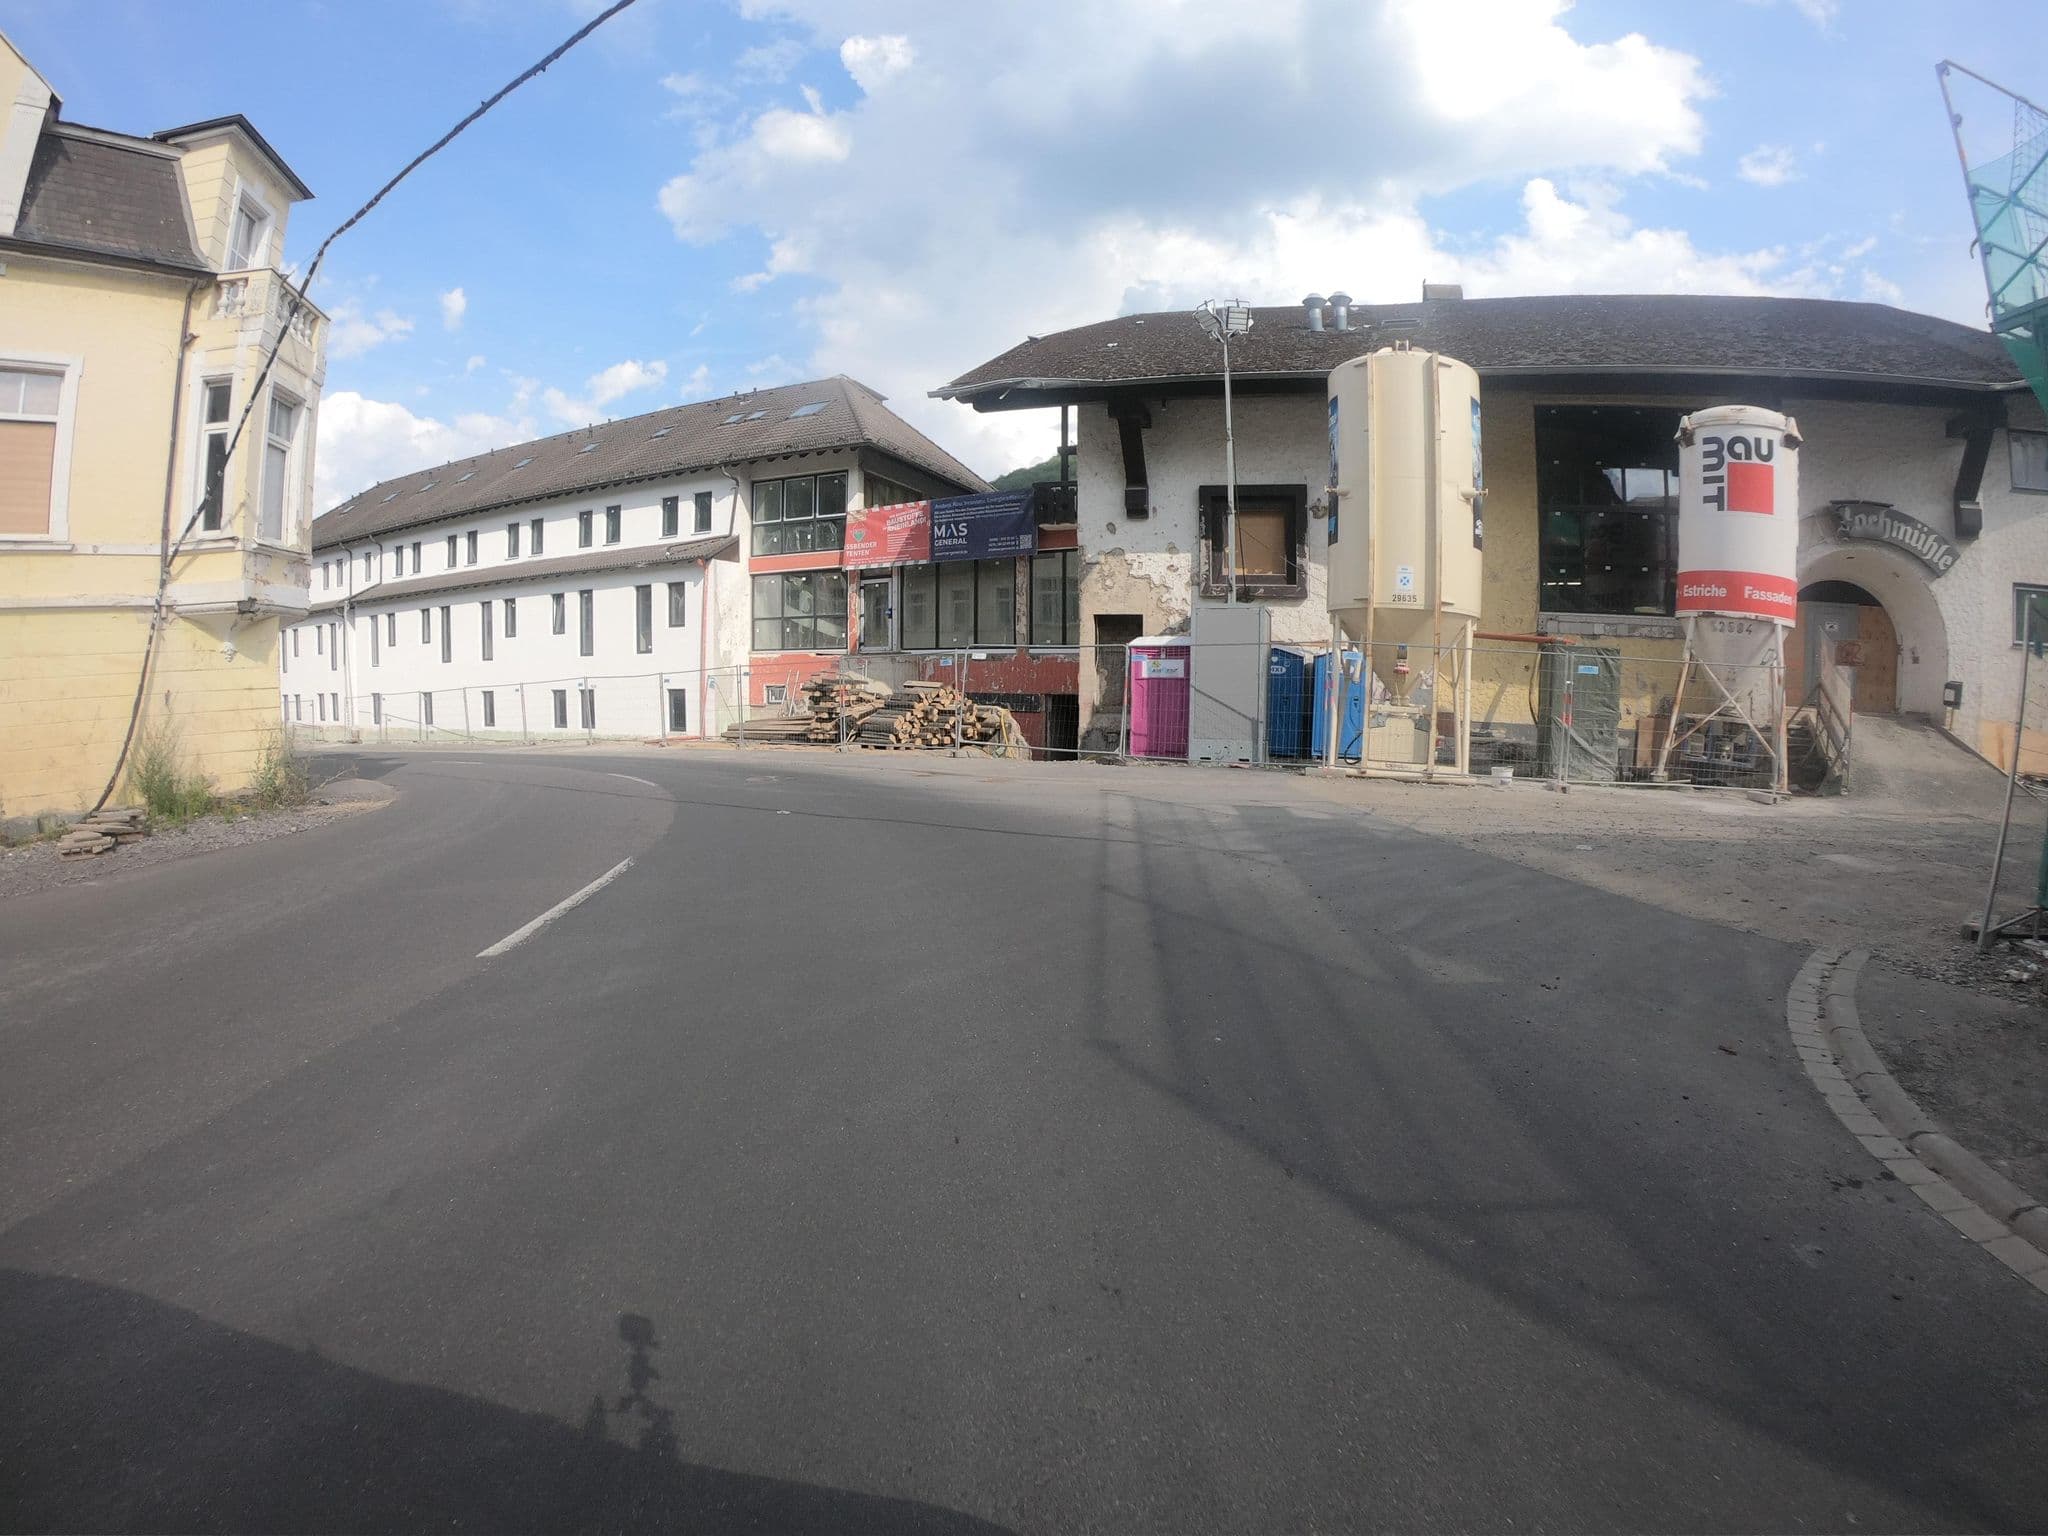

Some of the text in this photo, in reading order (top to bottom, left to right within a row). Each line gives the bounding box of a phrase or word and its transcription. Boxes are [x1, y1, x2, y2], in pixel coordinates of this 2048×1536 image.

[934, 538, 968, 547] GENERAL
[1683, 584, 1793, 605] Estriche Fassaden
